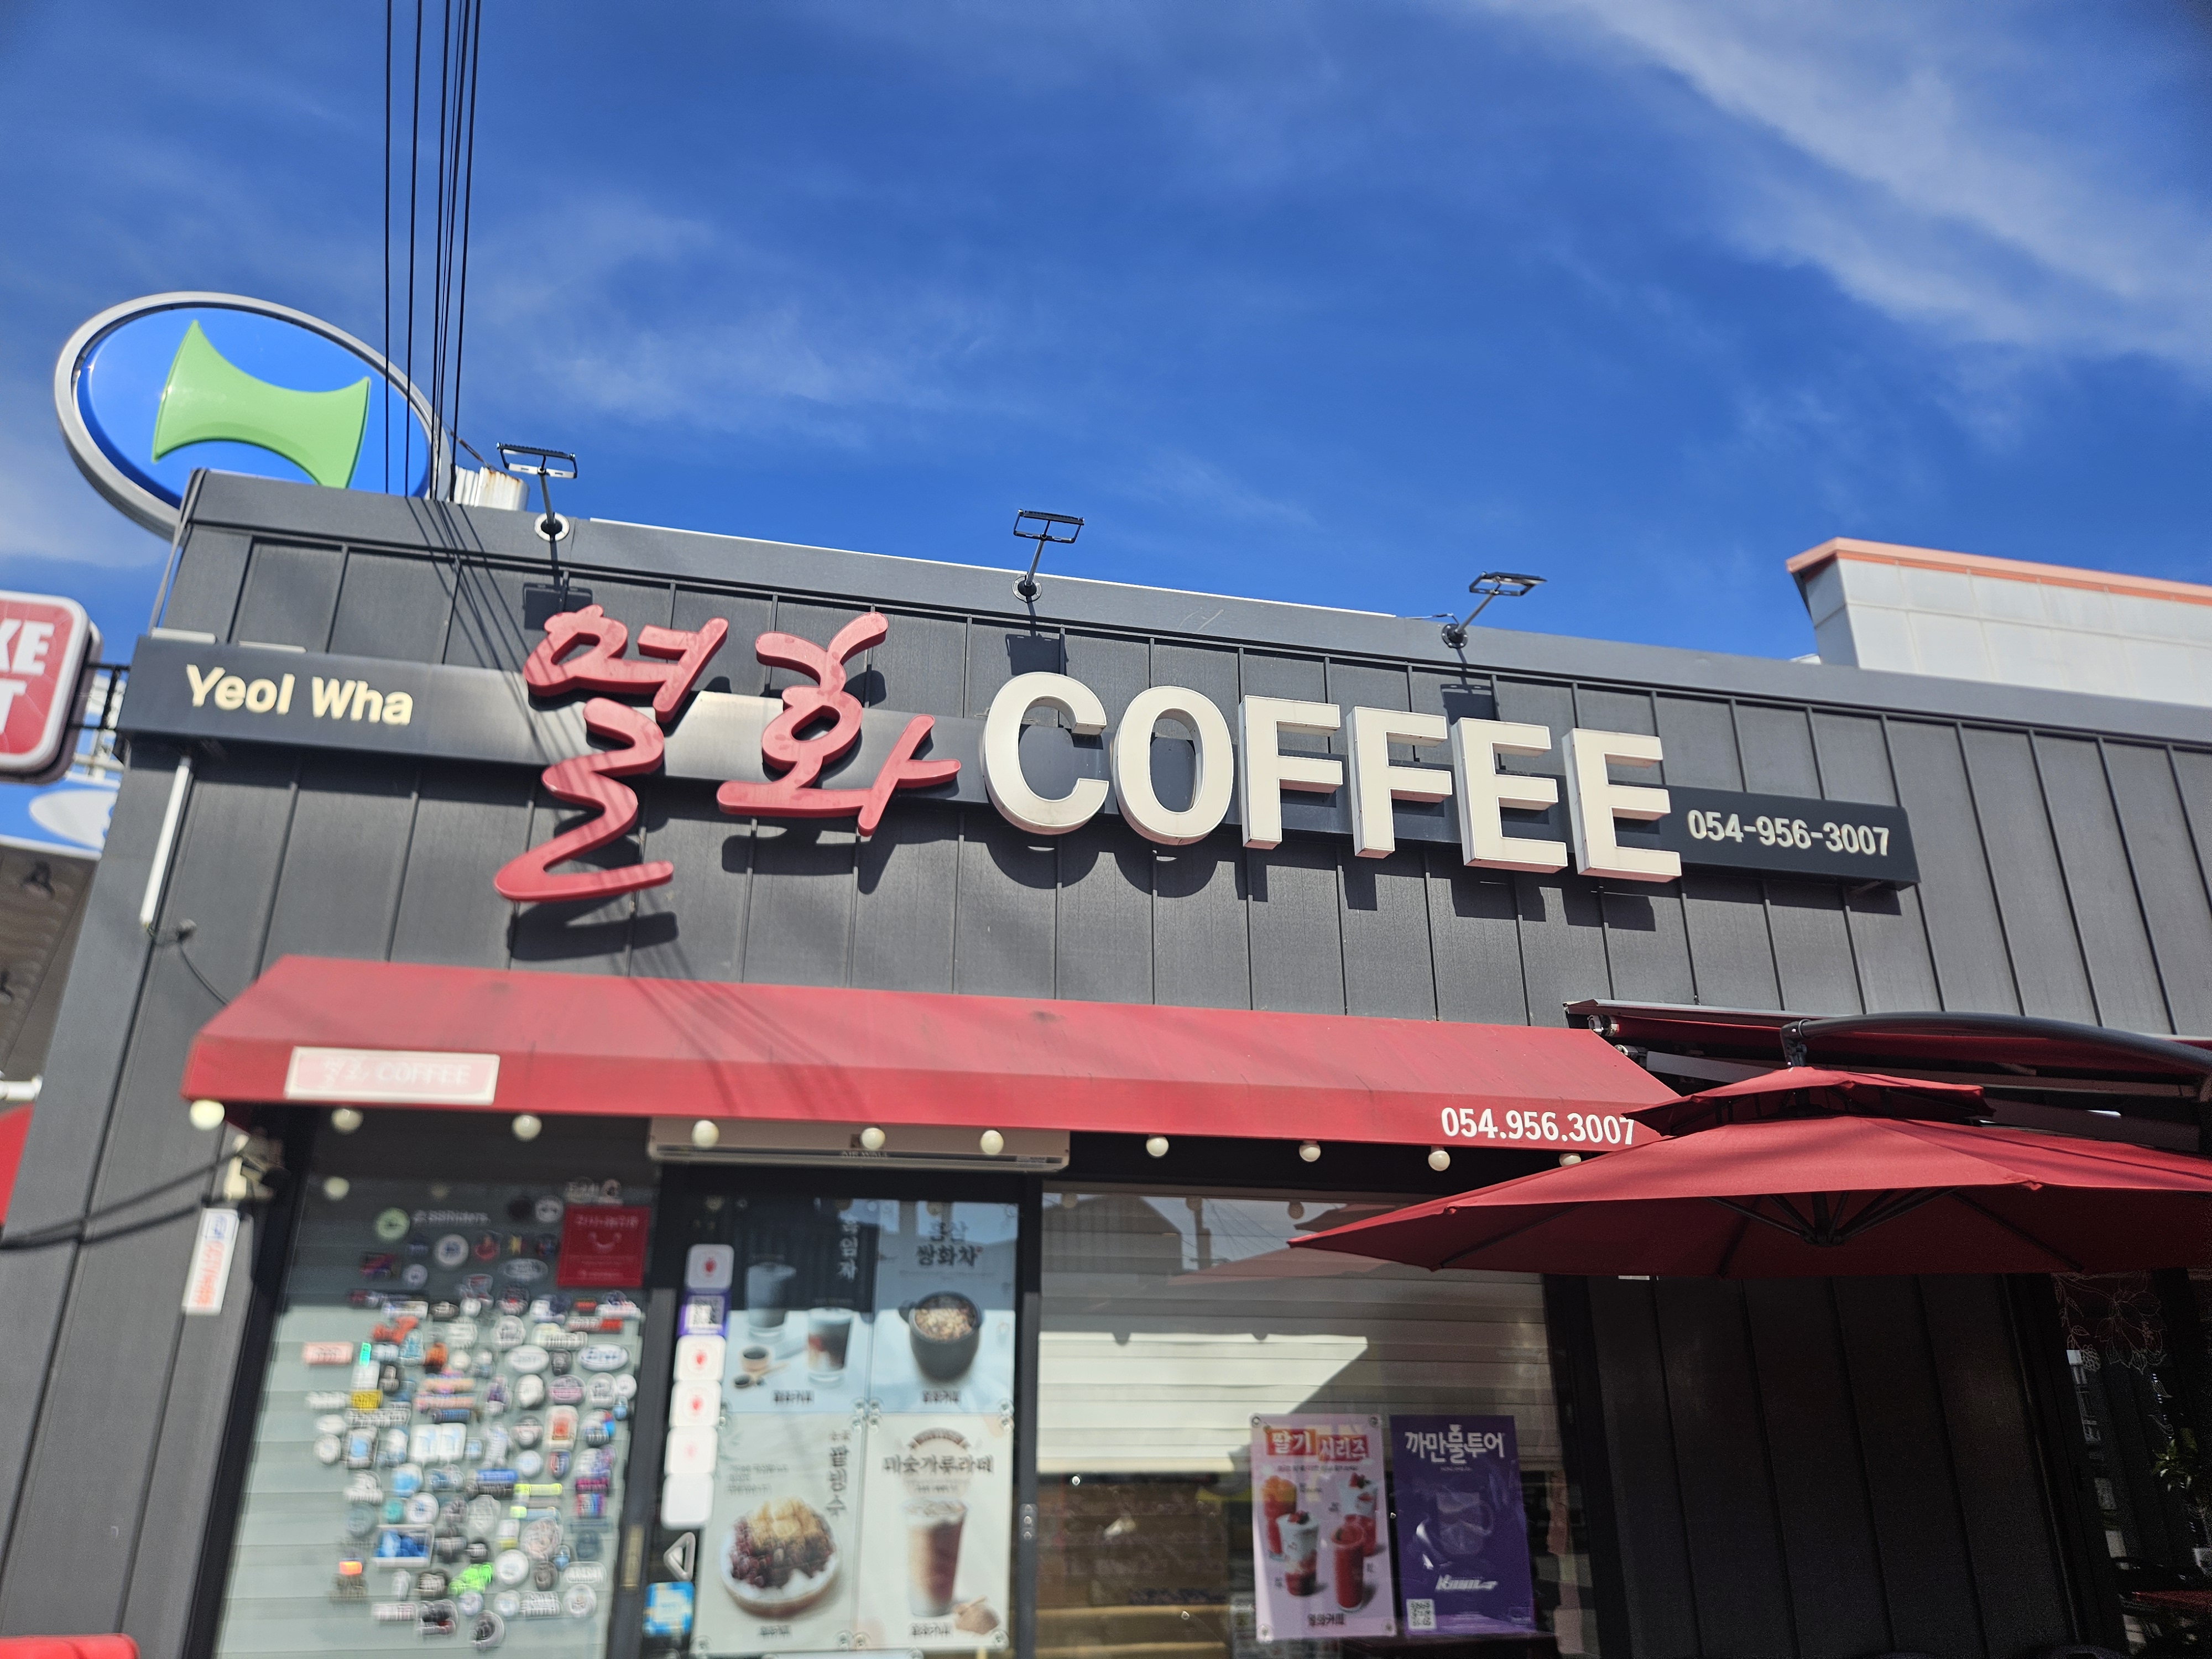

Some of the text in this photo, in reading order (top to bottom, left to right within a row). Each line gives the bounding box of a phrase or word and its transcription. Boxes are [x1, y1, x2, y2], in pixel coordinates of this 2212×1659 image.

[186, 664, 414, 726] Yeol Wha
[494, 604, 1682, 902] 열화 COFFEE
[1687, 808, 1890, 857] 054-956-3007
[375, 1061, 472, 1086] COFFEE
[1441, 1107, 1635, 1145] 054.956.3007
[1272, 1430, 1366, 1460] 딸기 시리즈
[1405, 1424, 1505, 1464] 까만물투어
